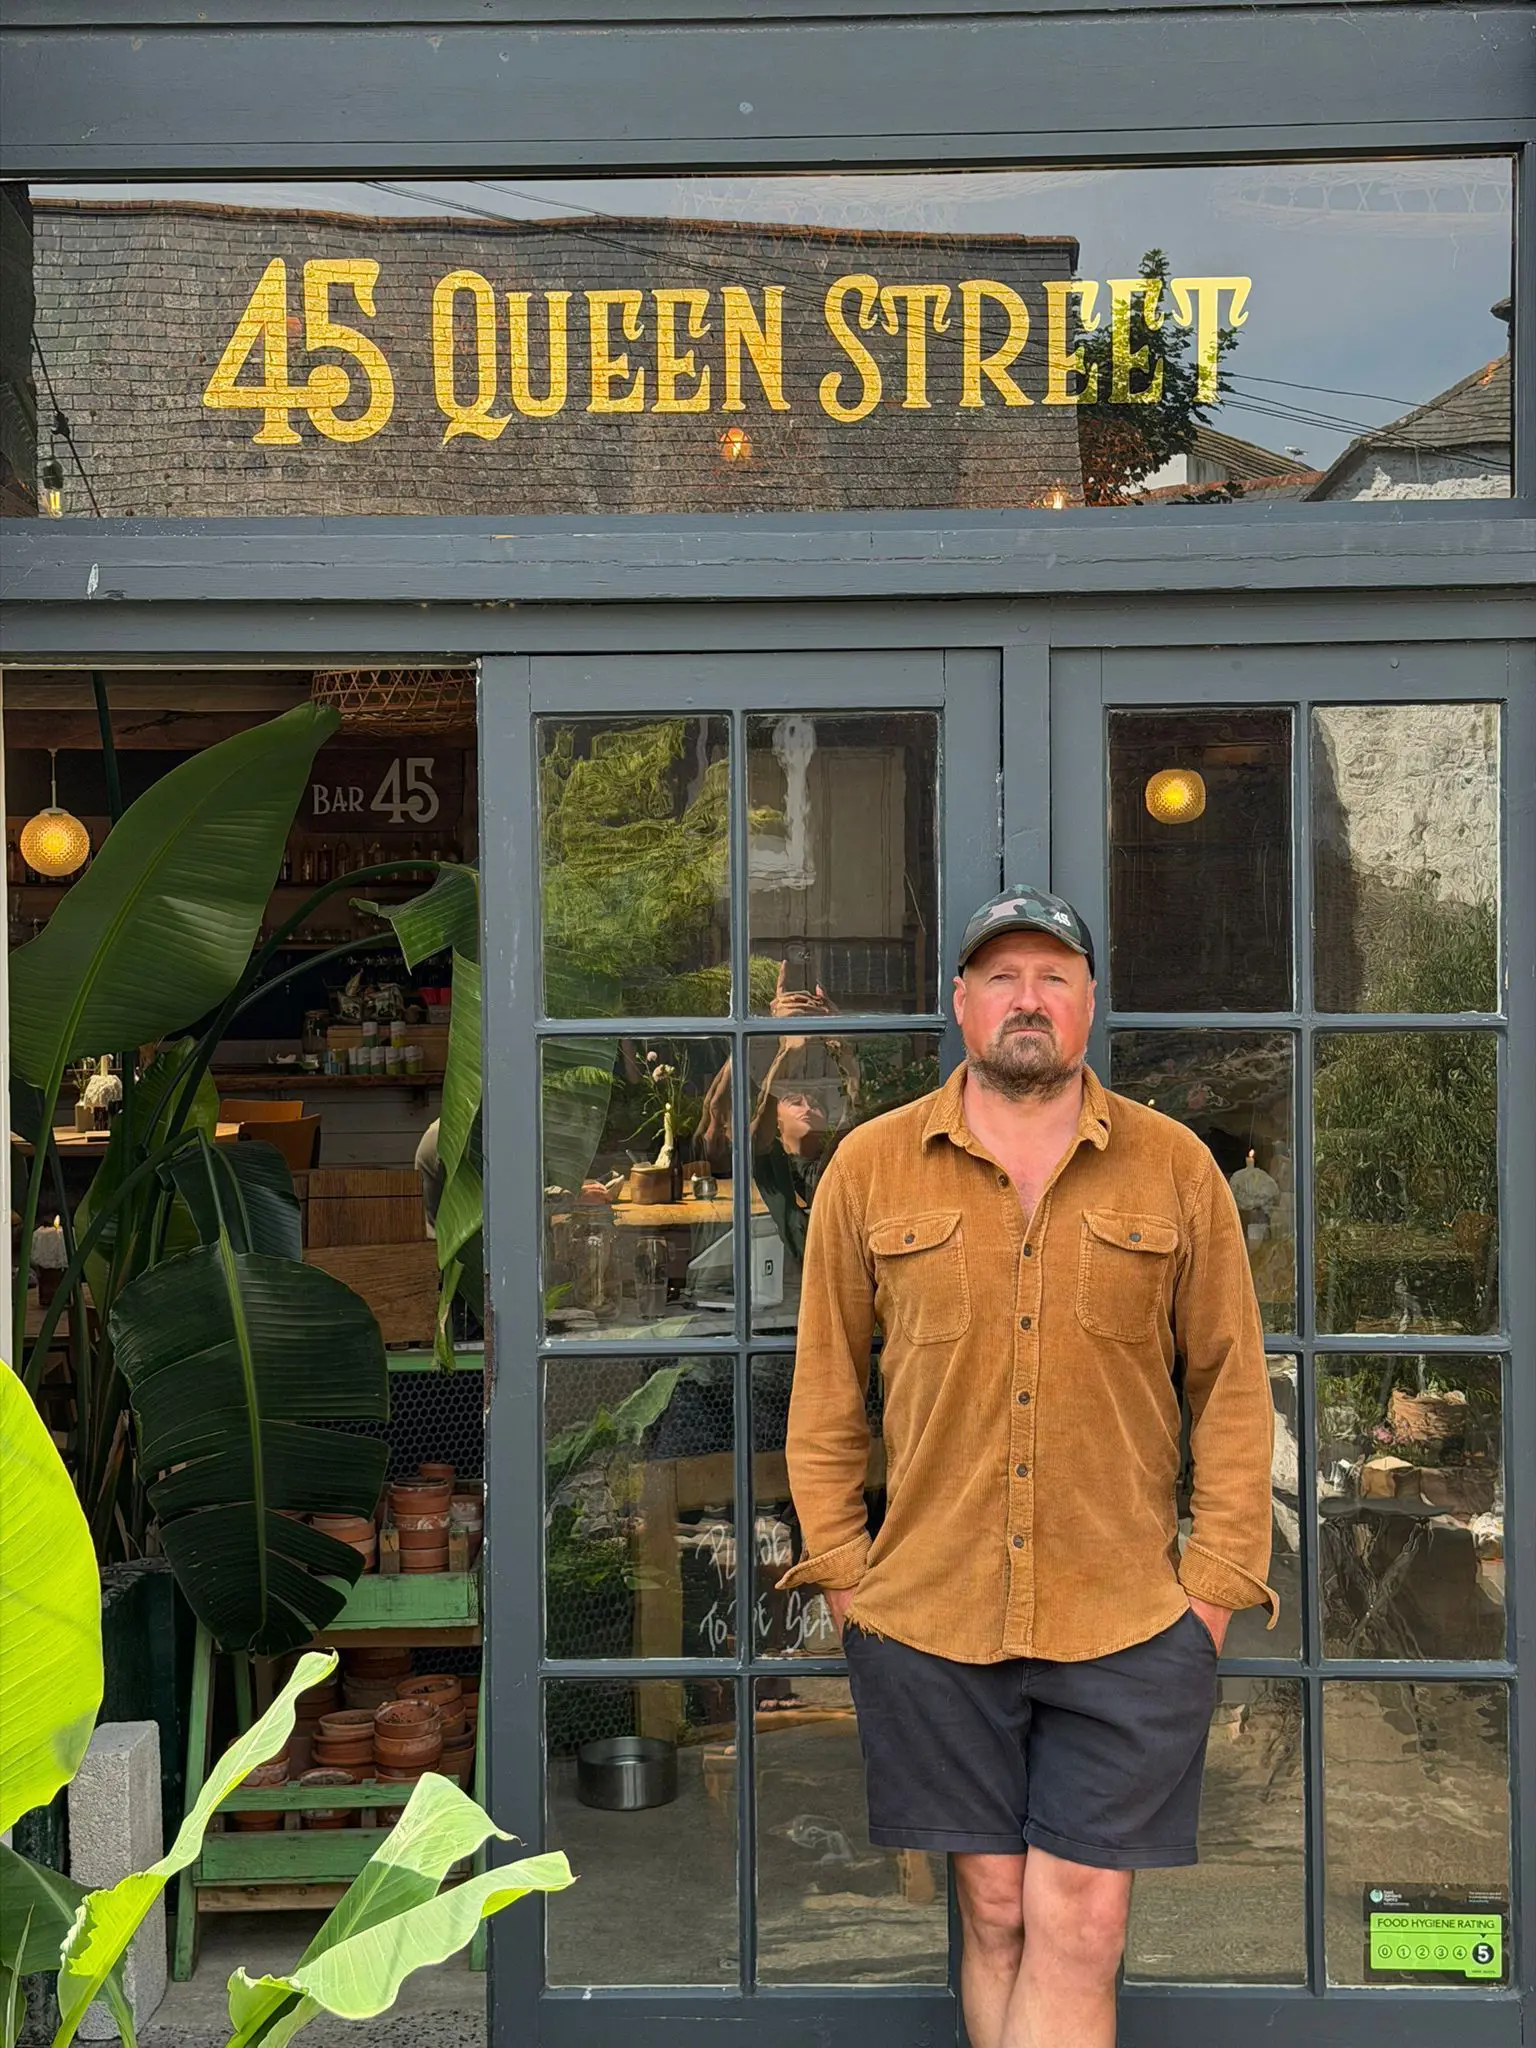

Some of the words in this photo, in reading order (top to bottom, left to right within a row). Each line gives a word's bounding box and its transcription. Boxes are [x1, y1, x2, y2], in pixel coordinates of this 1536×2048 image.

[203, 257, 395, 445] 45
[432, 269, 792, 446] QUEEN
[818, 273, 1252, 424] STREET
[312, 784, 365, 815] BAR
[370, 757, 440, 824] 45
[1377, 1918, 1409, 1928] FOOD
[1411, 1918, 1456, 1929] HYGIENE
[1457, 1919, 1495, 1929] RATING
[1477, 1945, 1490, 1963] 5
